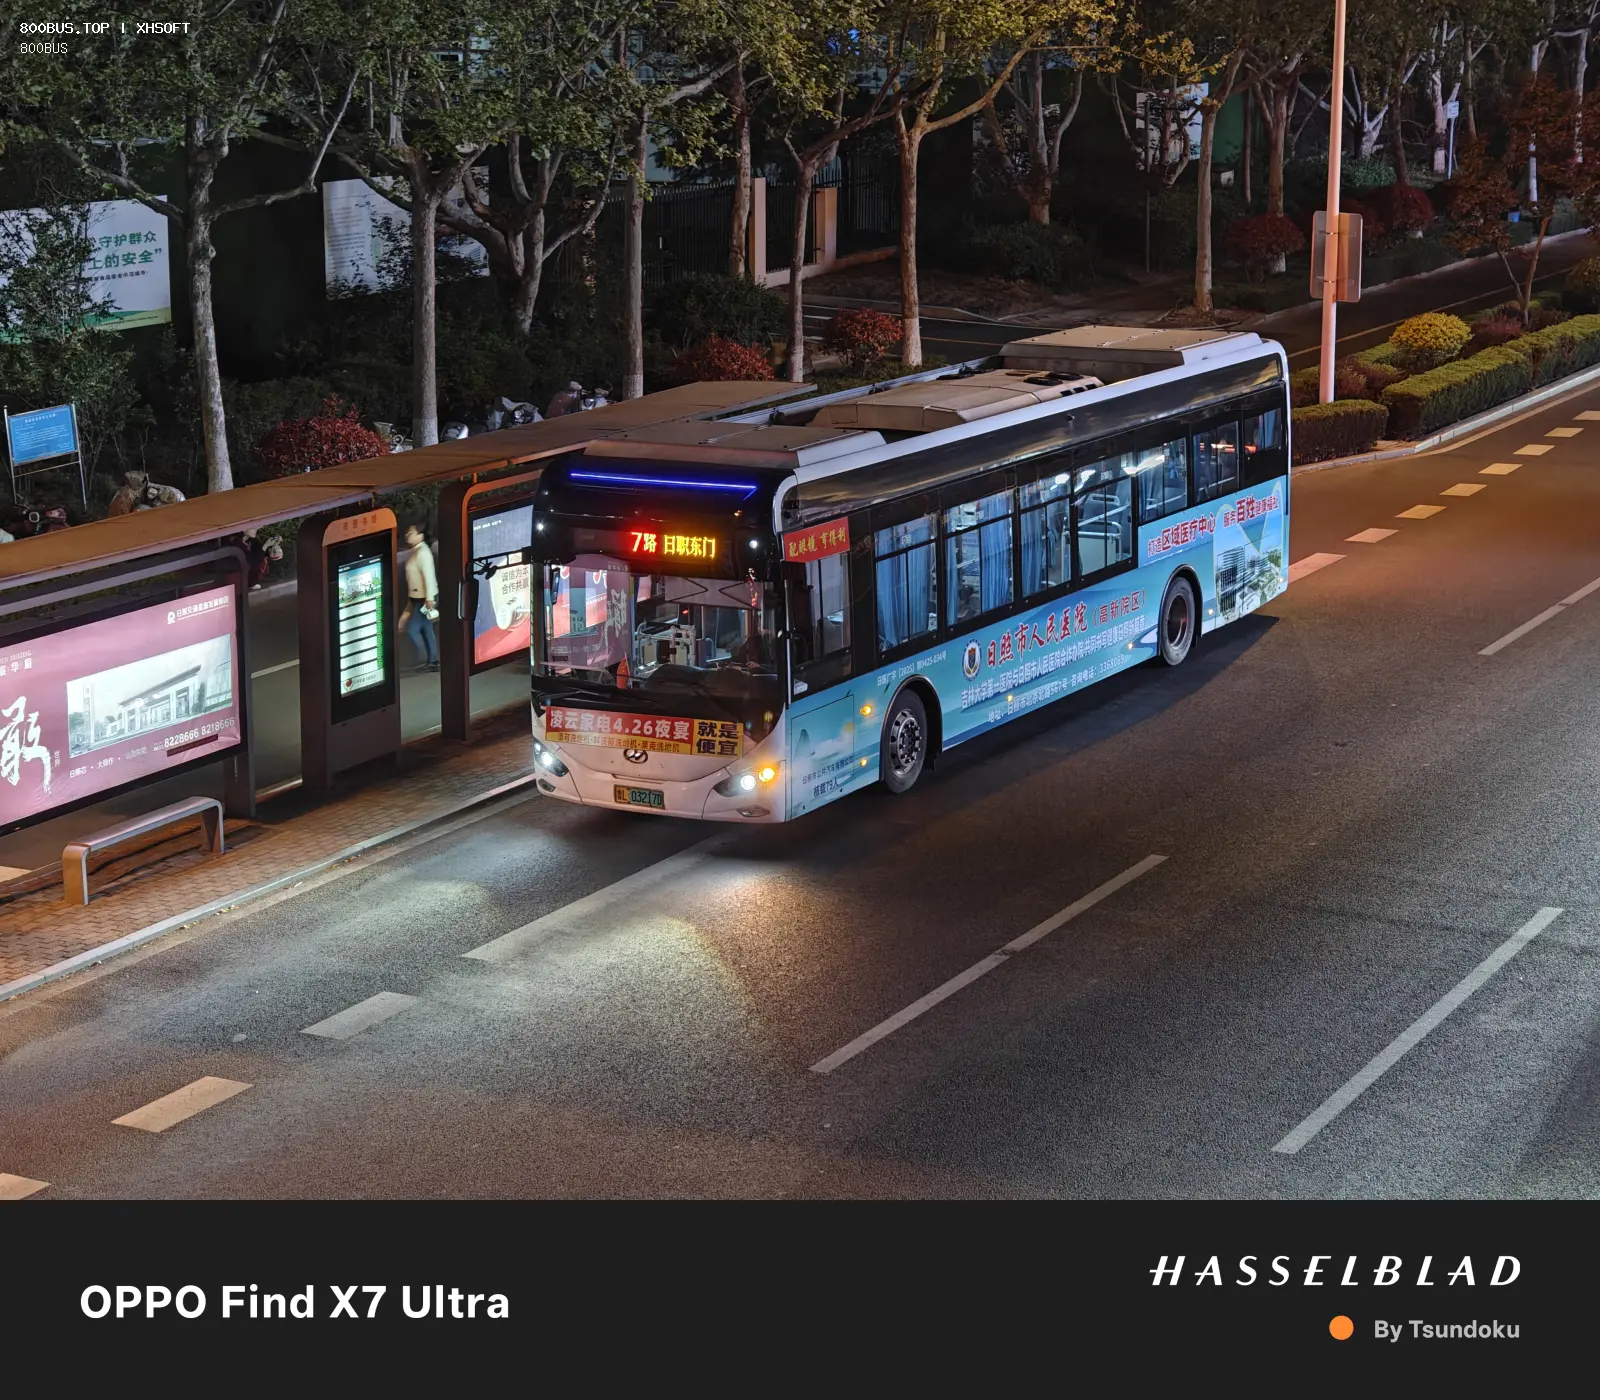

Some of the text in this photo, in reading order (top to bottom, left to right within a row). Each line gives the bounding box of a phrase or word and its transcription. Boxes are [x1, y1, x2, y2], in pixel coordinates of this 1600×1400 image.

[98, 230, 157, 248] 守护群众
[631, 531, 716, 559] 7路 日职东门
[1148, 512, 1216, 557] 打造区域医疗中心
[502, 578, 529, 595] 合作共赢
[987, 601, 1088, 667] 日照市人民医院
[550, 709, 690, 741] 凌云家电4.26夜宴
[697, 721, 739, 739] 就是
[163, 728, 200, 749] 8228666
[696, 738, 738, 756] 便宜
